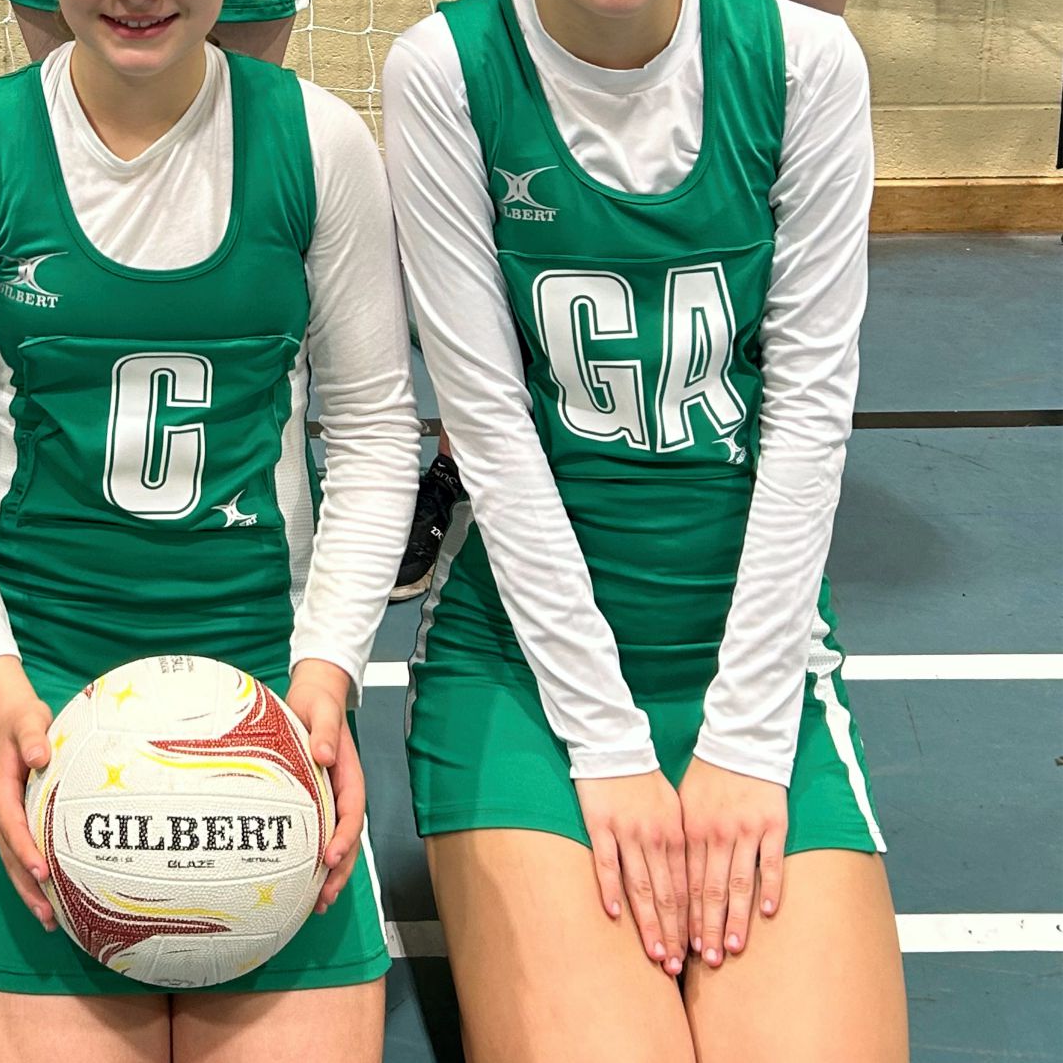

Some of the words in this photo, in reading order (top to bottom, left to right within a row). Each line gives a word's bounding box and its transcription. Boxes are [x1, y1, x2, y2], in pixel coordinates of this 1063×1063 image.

[532, 262, 747, 453] GA
[102, 352, 214, 520] C
[84, 812, 293, 852] GILBERT
[167, 859, 216, 869] BLAZE
